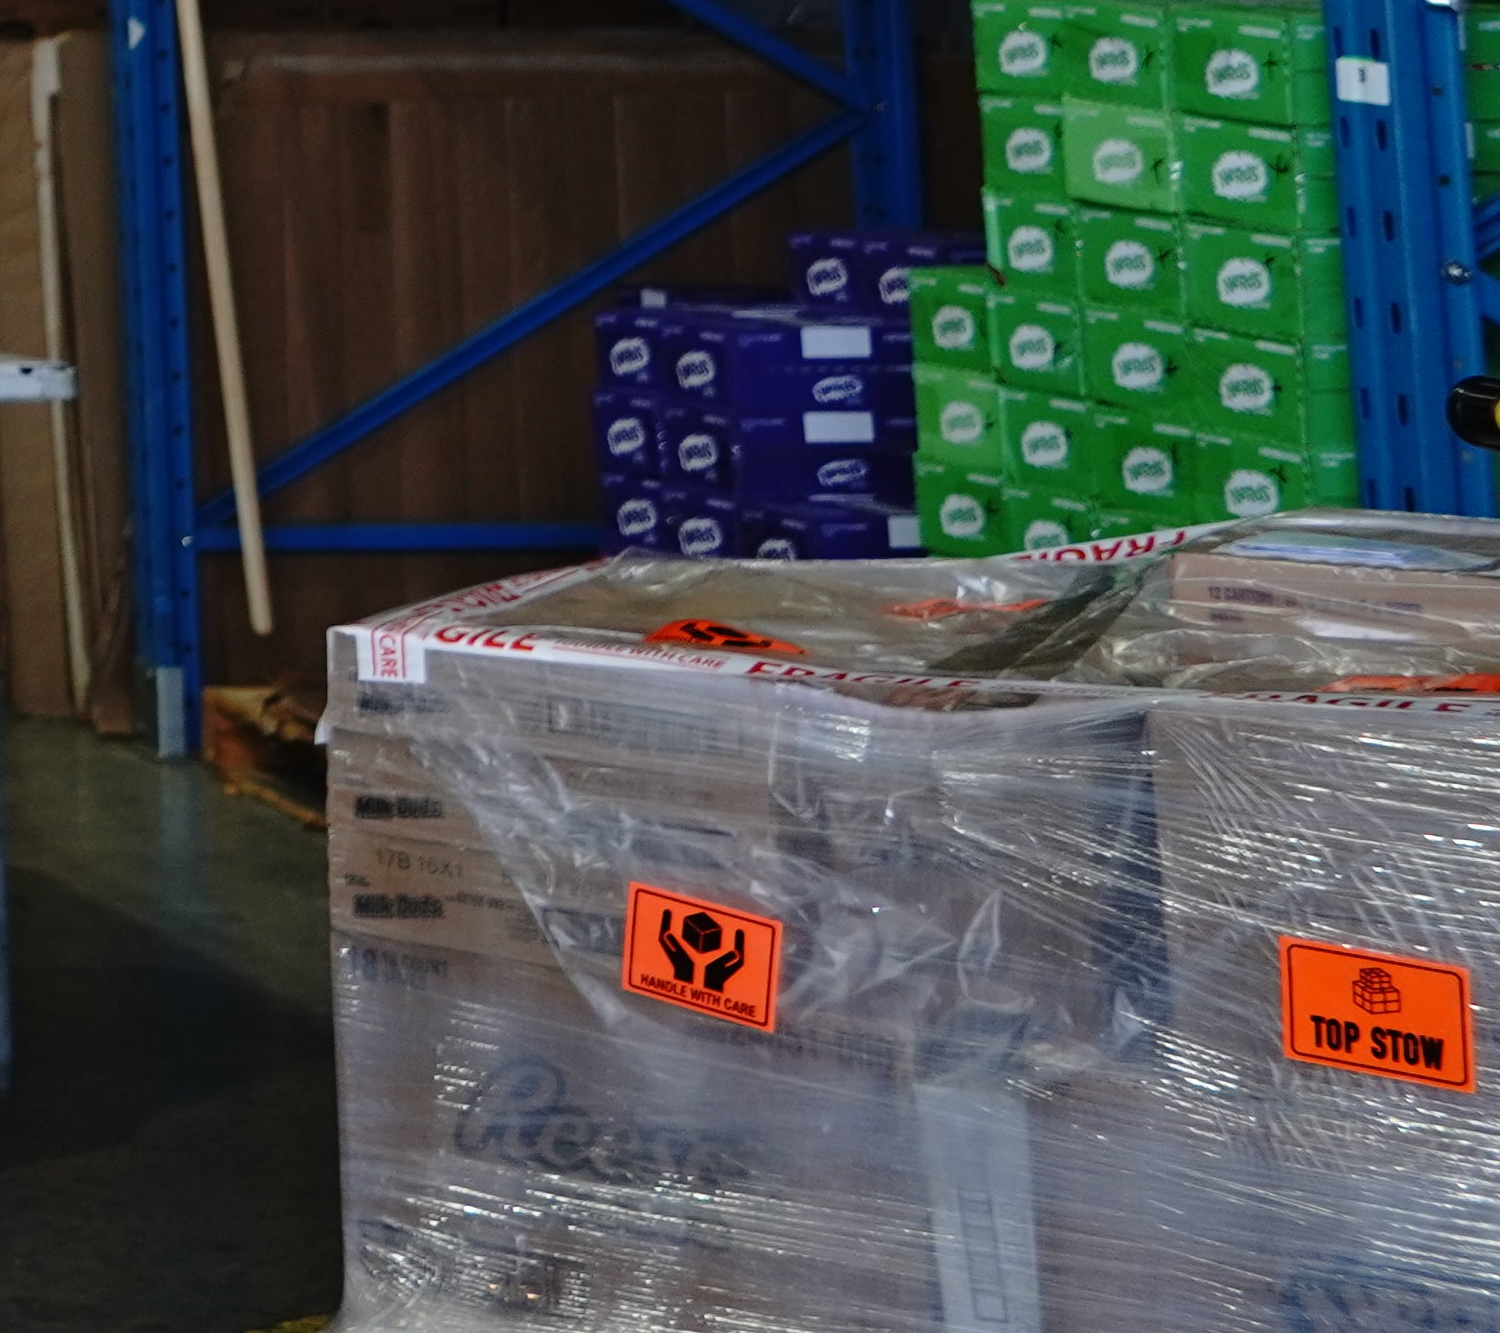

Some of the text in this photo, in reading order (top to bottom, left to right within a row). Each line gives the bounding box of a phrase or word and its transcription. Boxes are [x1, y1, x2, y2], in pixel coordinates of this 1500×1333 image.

[639, 972, 757, 1018] HANDLE WITH CARE
[1310, 1014, 1444, 1071] TOP STOW
